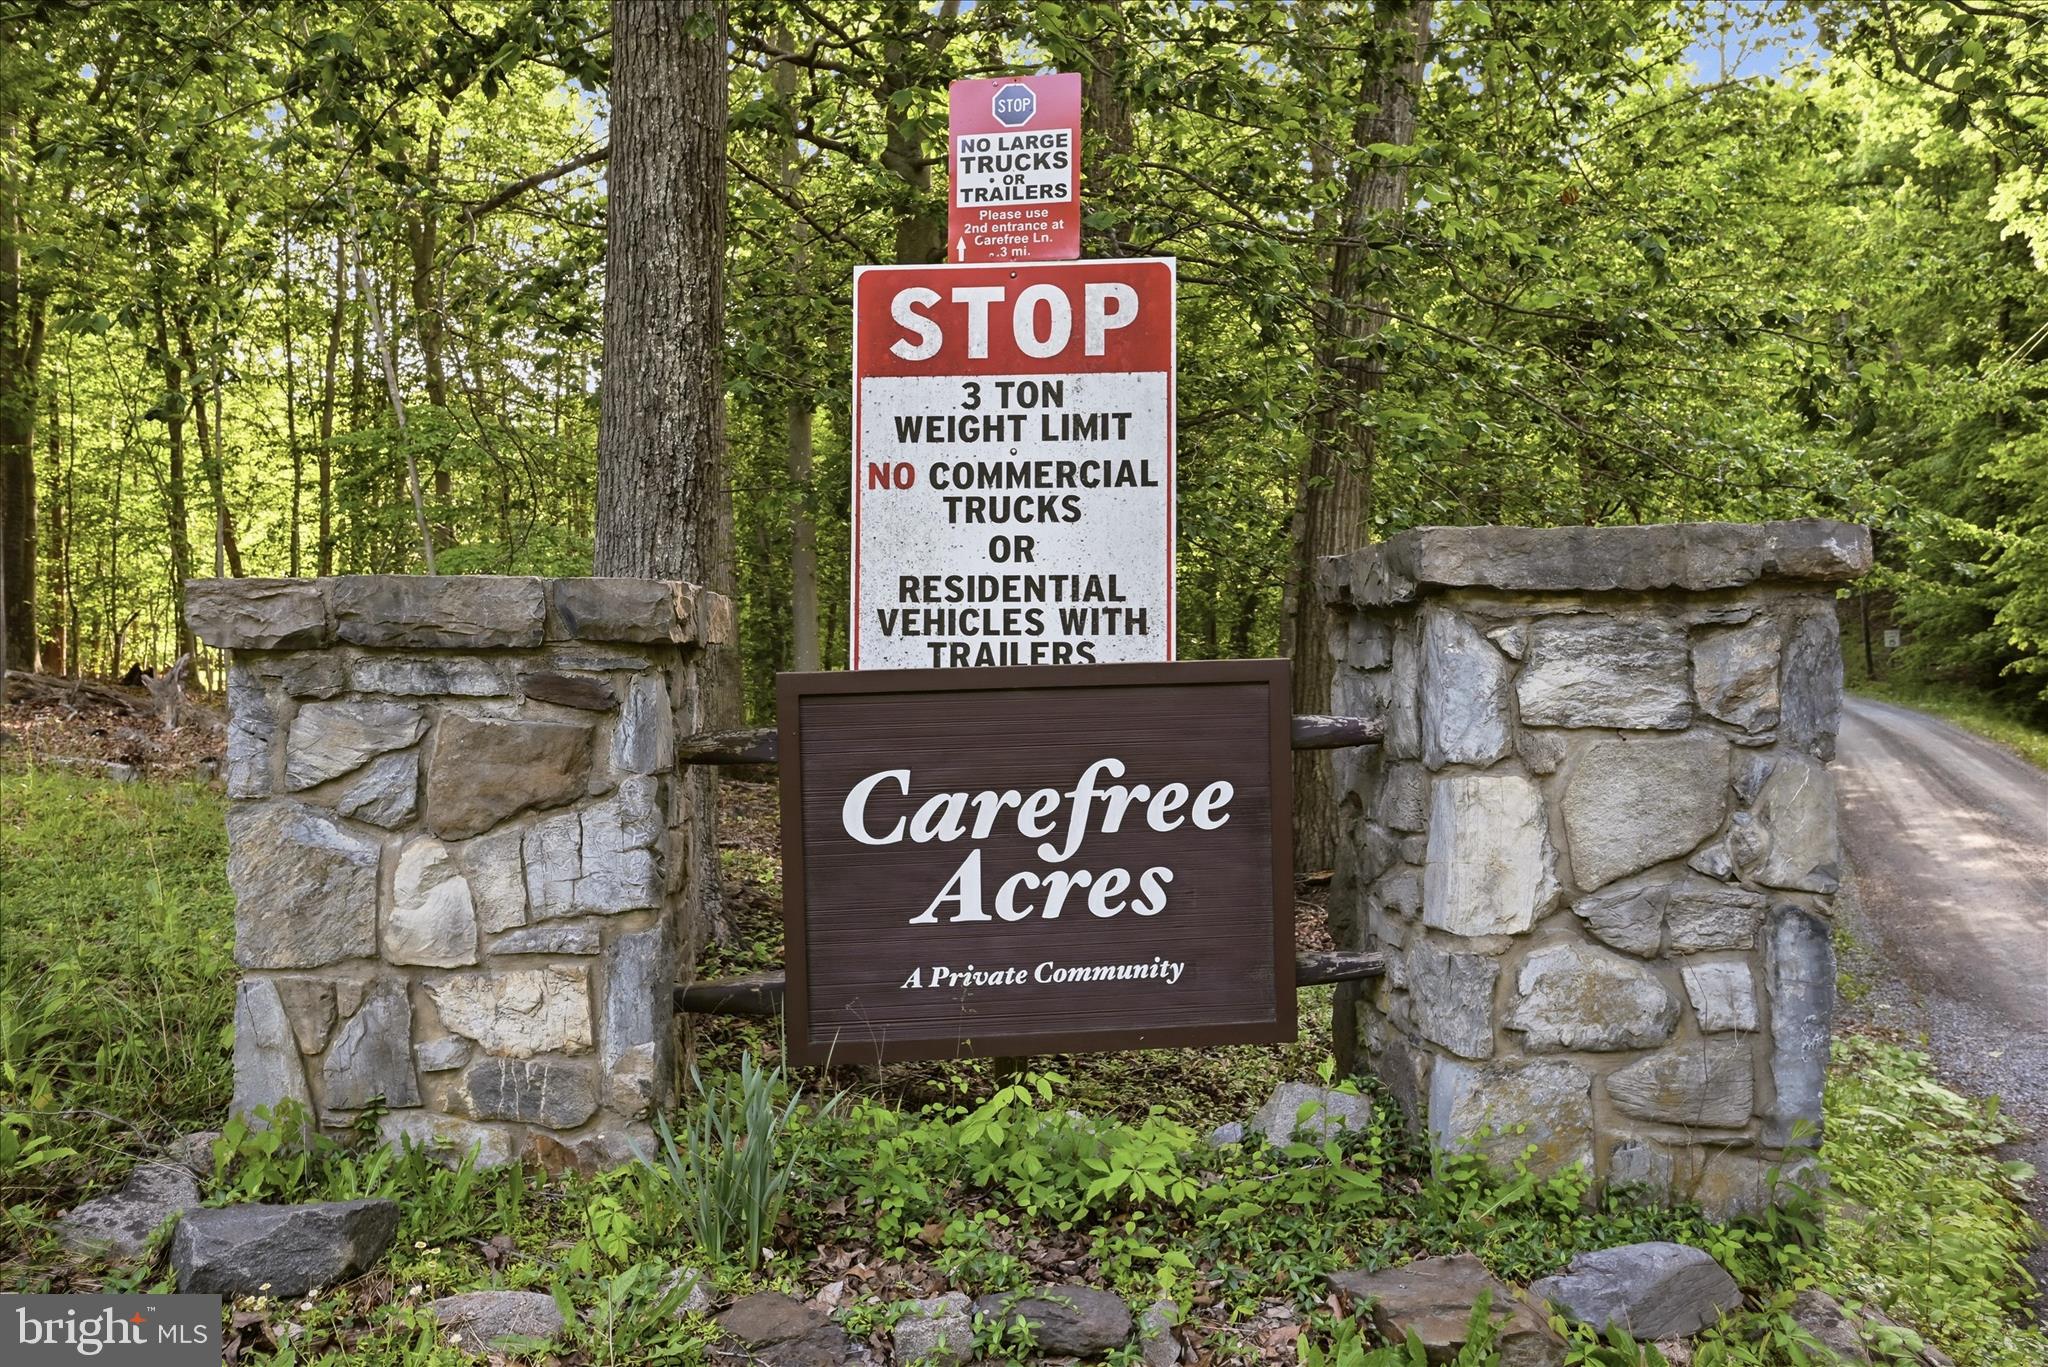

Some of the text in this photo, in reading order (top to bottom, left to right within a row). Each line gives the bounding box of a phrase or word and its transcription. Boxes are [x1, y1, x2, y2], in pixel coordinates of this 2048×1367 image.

[998, 97, 1031, 113] STOP
[961, 133, 1068, 153] NO LARGE
[960, 151, 1068, 174] TRUCKS
[960, 183, 1068, 203] TRAILERS
[1003, 174, 1025, 186] OR
[964, 219, 1064, 234] 2nd entrance at
[979, 209, 1049, 221] Please use
[974, 233, 1053, 246] Carefree Ln.
[1011, 246, 1031, 256] mi.
[889, 283, 1139, 361] STOP
[961, 380, 1064, 410] 3 TON
[895, 412, 1132, 443] WEIGHT LIMIT
[868, 459, 1158, 490] NO COMMERCIAL
[943, 495, 1082, 524] TRUCKS
[988, 535, 1035, 563] OR
[899, 574, 1126, 603] RESIDENTIAL
[877, 606, 1147, 637] VEHICLES WITH
[927, 641, 1096, 668] TRAILERS
[842, 758, 1234, 862] Carefree
[909, 849, 1174, 924] Acres
[900, 956, 1185, 989] A Private Community
